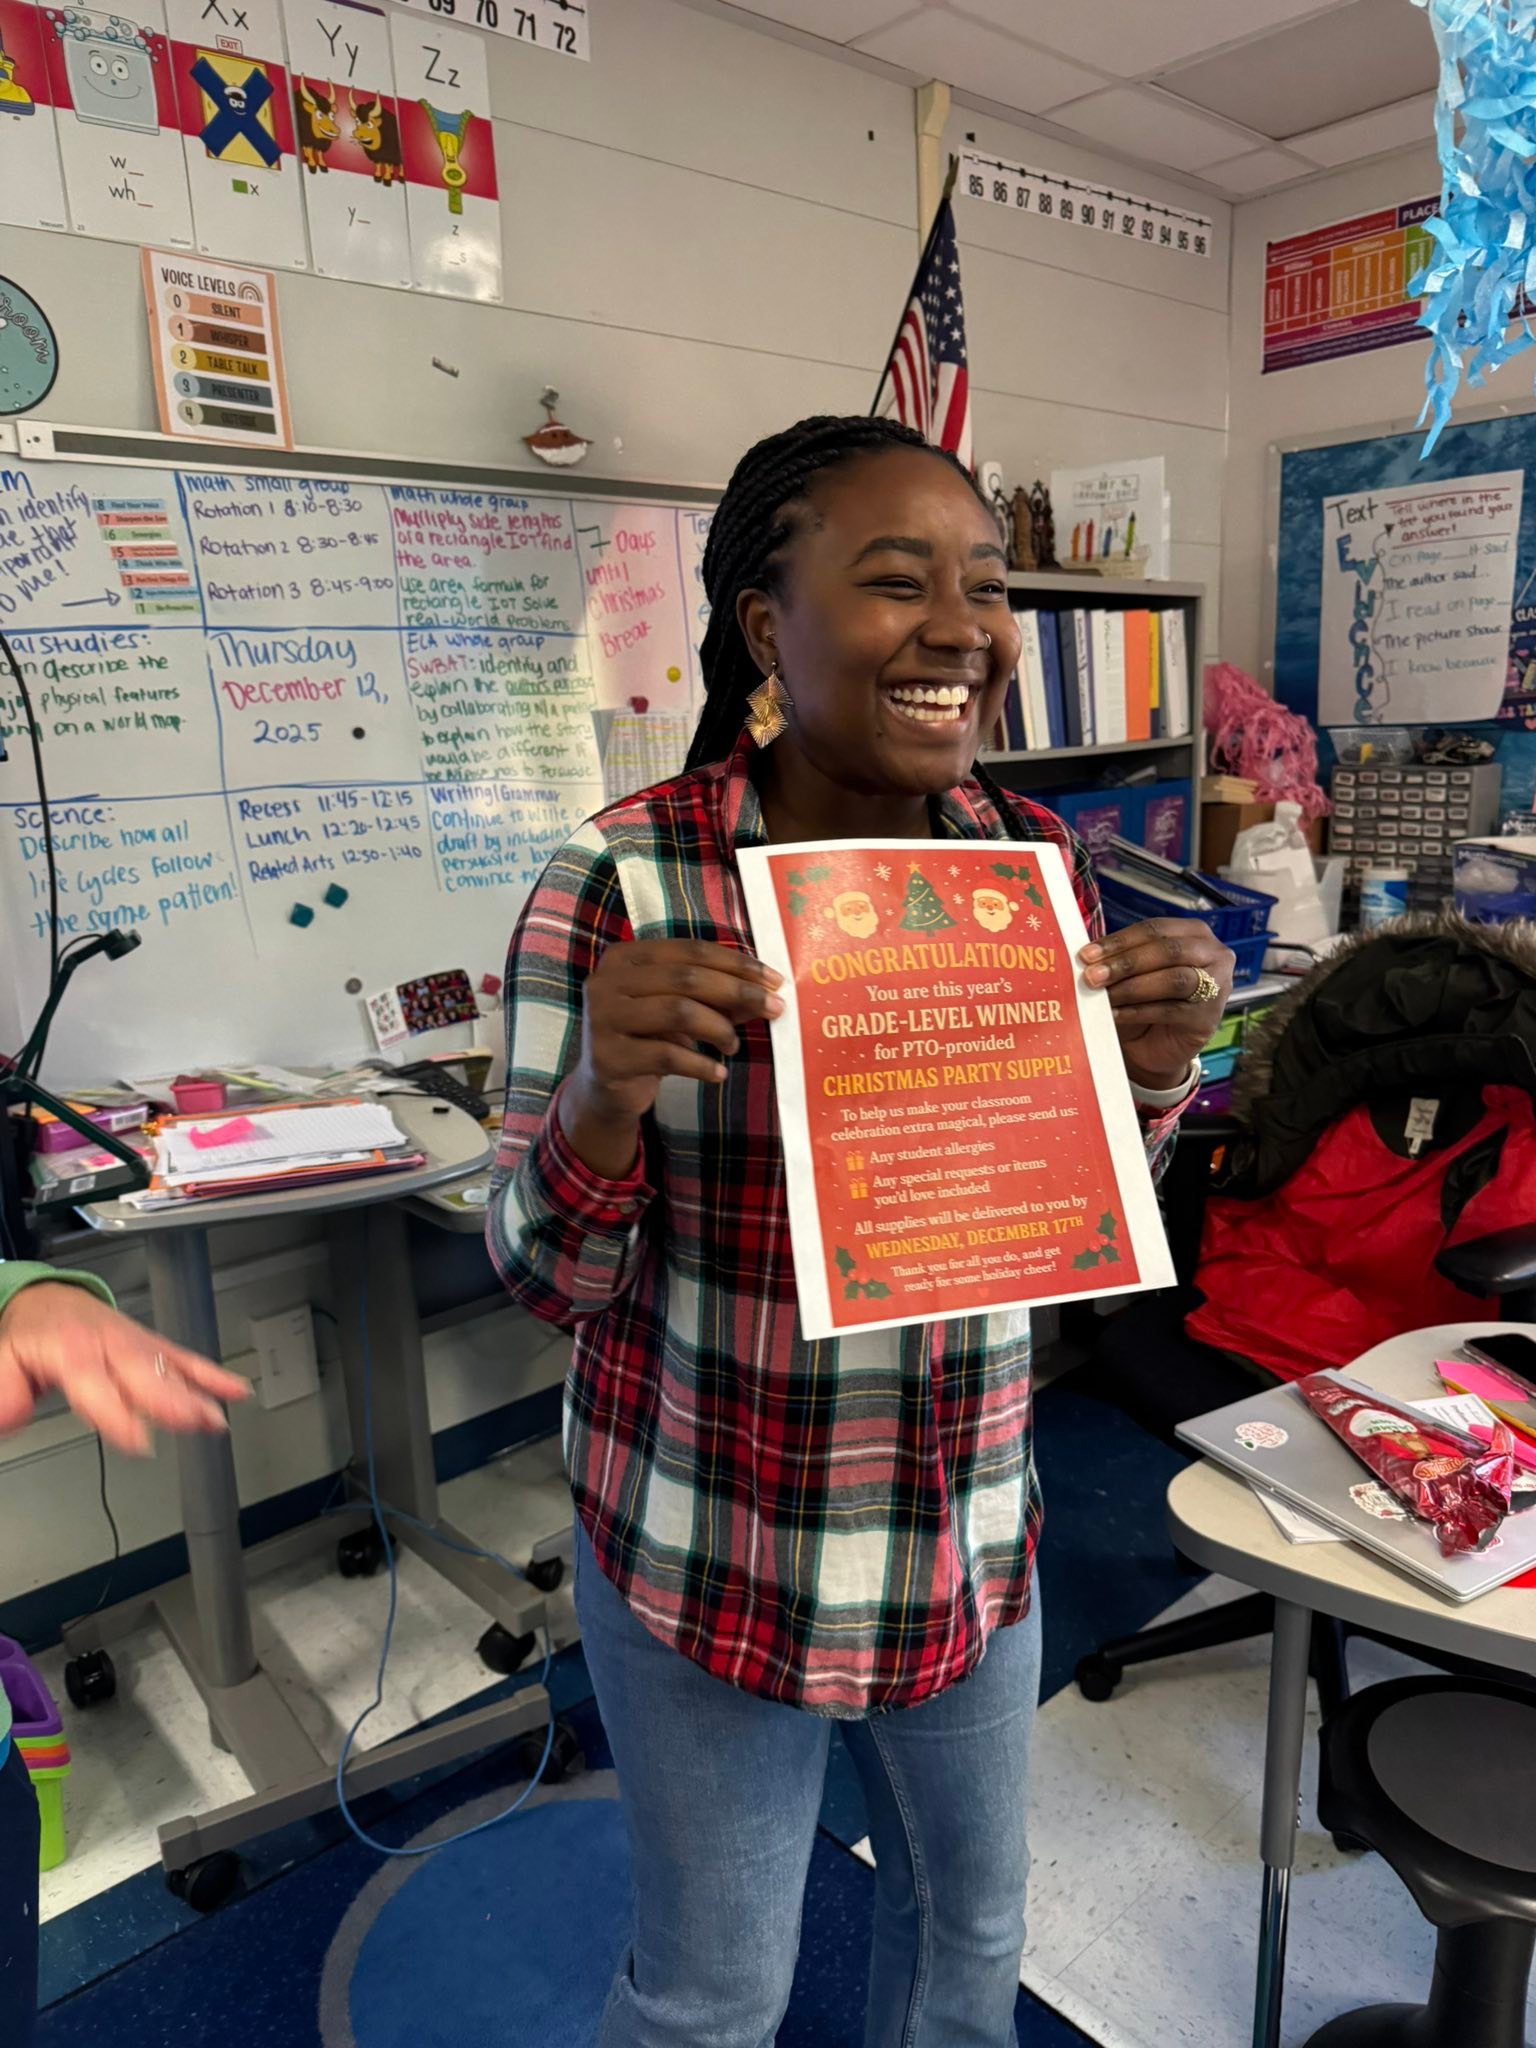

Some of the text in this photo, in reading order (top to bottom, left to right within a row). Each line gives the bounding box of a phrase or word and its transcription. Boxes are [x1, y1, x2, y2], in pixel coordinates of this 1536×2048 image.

[477, 0, 577, 55] 70 71 72
[220, 39, 238, 50] EXIT
[969, 174, 1206, 255] 85 86 87 88 89 90 91 92 93 94 95 96
[161, 267, 236, 297] VOICE LEVELS
[211, 302, 241, 319] SILENT
[177, 323, 249, 347] 1 WHISPER
[180, 350, 258, 375] 2 TABLE TALK
[182, 379, 190, 393] 3
[185, 406, 193, 420] 4
[97, 500, 105, 511] 8
[194, 500, 262, 519] Rotation
[1327, 497, 1378, 530] Text
[103, 514, 111, 524] 7
[108, 529, 116, 540] 6
[200, 536, 290, 556] Rotation 2
[116, 547, 124, 557] 5
[125, 574, 133, 586] 3
[207, 581, 285, 601] Rotation
[290, 582, 300, 599] 3
[134, 588, 143, 599] 2
[138, 655, 168, 670] the
[210, 632, 357, 668] Thursday
[222, 676, 347, 711] December
[253, 719, 323, 744] 2025
[14, 807, 116, 829] Scence:
[238, 798, 302, 821] Recess
[811, 944, 1055, 985] CONGRATULATIONS!
[865, 977, 1012, 1002] You are this year's
[821, 1000, 1063, 1039] GRADE-LEVEL WINNER
[874, 1034, 1015, 1061] for PTO-provided
[823, 1067, 939, 1097] CHRISTMAS
[943, 1062, 1003, 1086] PARTY
[840, 1095, 1032, 1122] To help us make your classroom
[831, 1106, 1079, 1142] celebration extra magical, please send us:
[870, 1140, 996, 1165] Any student allergies
[873, 1159, 1048, 1189] Any special requests or items
[909, 1189, 937, 1203] love
[937, 1180, 991, 1199] included
[854, 1194, 1088, 1235] All supplies will be delivered to you by
[865, 1215, 1084, 1259] WEDNESDAY, DECEMBER 17TH
[890, 1262, 928, 1277] Thank
[927, 1262, 948, 1275] you
[948, 1258, 965, 1270] for
[966, 1255, 981, 1267] all
[981, 1256, 1003, 1268] you
[1022, 1247, 1043, 1260] and
[1044, 1246, 1061, 1260] get
[904, 1260, 1057, 1292] ready for some holiday cheer!
